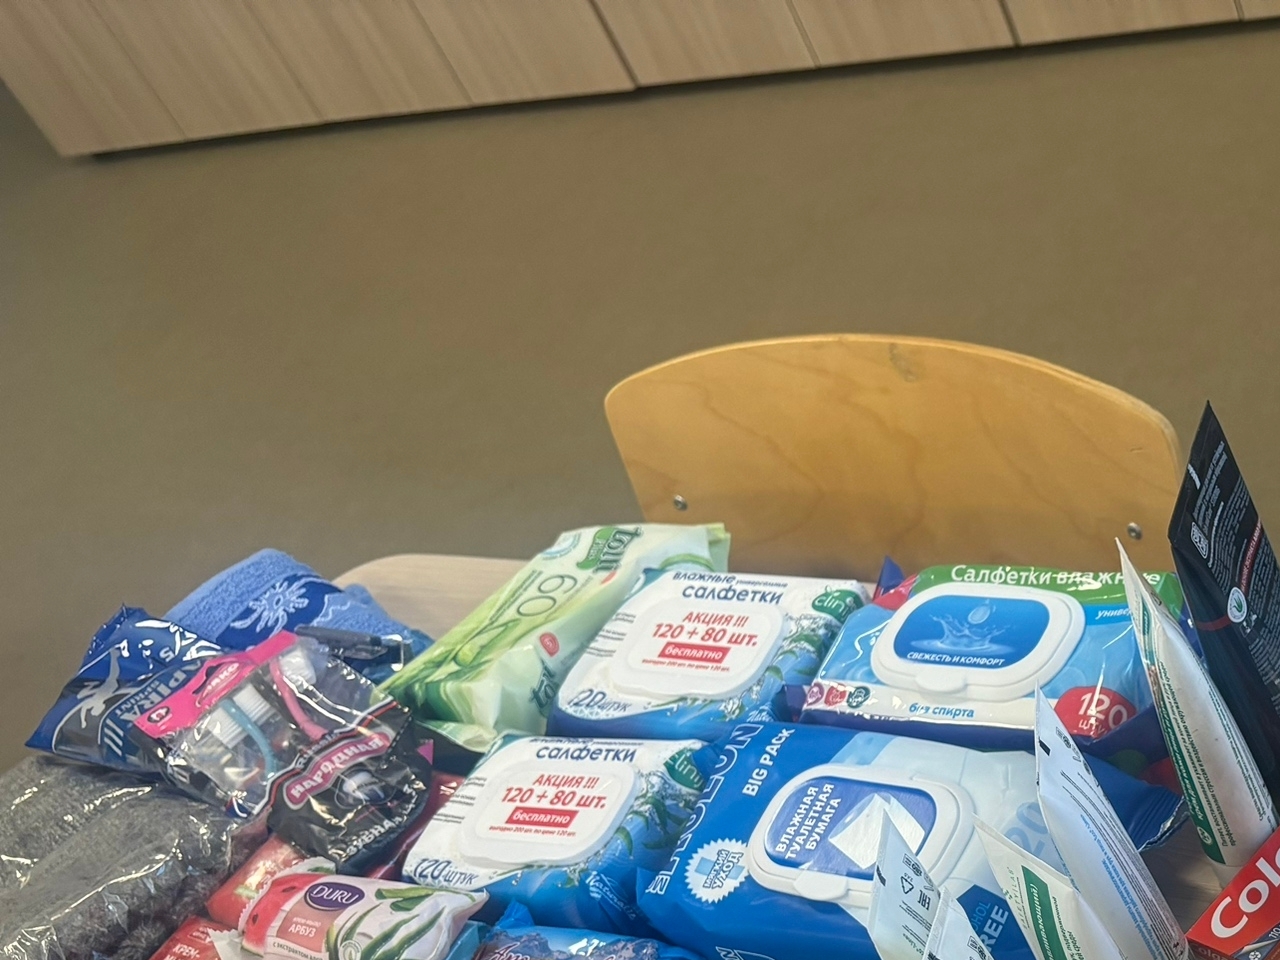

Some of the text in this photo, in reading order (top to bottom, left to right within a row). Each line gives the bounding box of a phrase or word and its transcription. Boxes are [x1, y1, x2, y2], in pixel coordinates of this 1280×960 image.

[951, 565, 1160, 589] Салфетки влажне
[516, 574, 578, 617] 60
[682, 583, 784, 604] салфетки
[682, 611, 734, 627] АКЦИЯ
[652, 622, 758, 648] 120 80 шт.
[664, 645, 725, 661] бесплатно
[906, 652, 1005, 668] СВЕЖЕСТЬ КОМФОРТ
[932, 704, 975, 719] спирта
[1078, 692, 1128, 727] 120
[535, 744, 637, 763] салфетки
[741, 720, 796, 799] BIG PACK
[290, 738, 384, 799] НАРОДНАЯ
[532, 774, 584, 788] АКЦИЯ
[501, 787, 607, 810] 120 + 80 шт.
[512, 810, 572, 825] бесплатно
[776, 786, 820, 854] ВЛАЖНАЯ
[785, 782, 836, 860] ТУАЛЕТНАЯ
[806, 796, 842, 850] БУМАГА
[413, 857, 478, 886] 120 штук
[700, 846, 730, 890] МЯГКИЙ
[710, 846, 744, 893] УХОД
[308, 884, 360, 905] DURU
[288, 923, 317, 938] АРБУЗ
[173, 941, 201, 960] КРЕМ-
